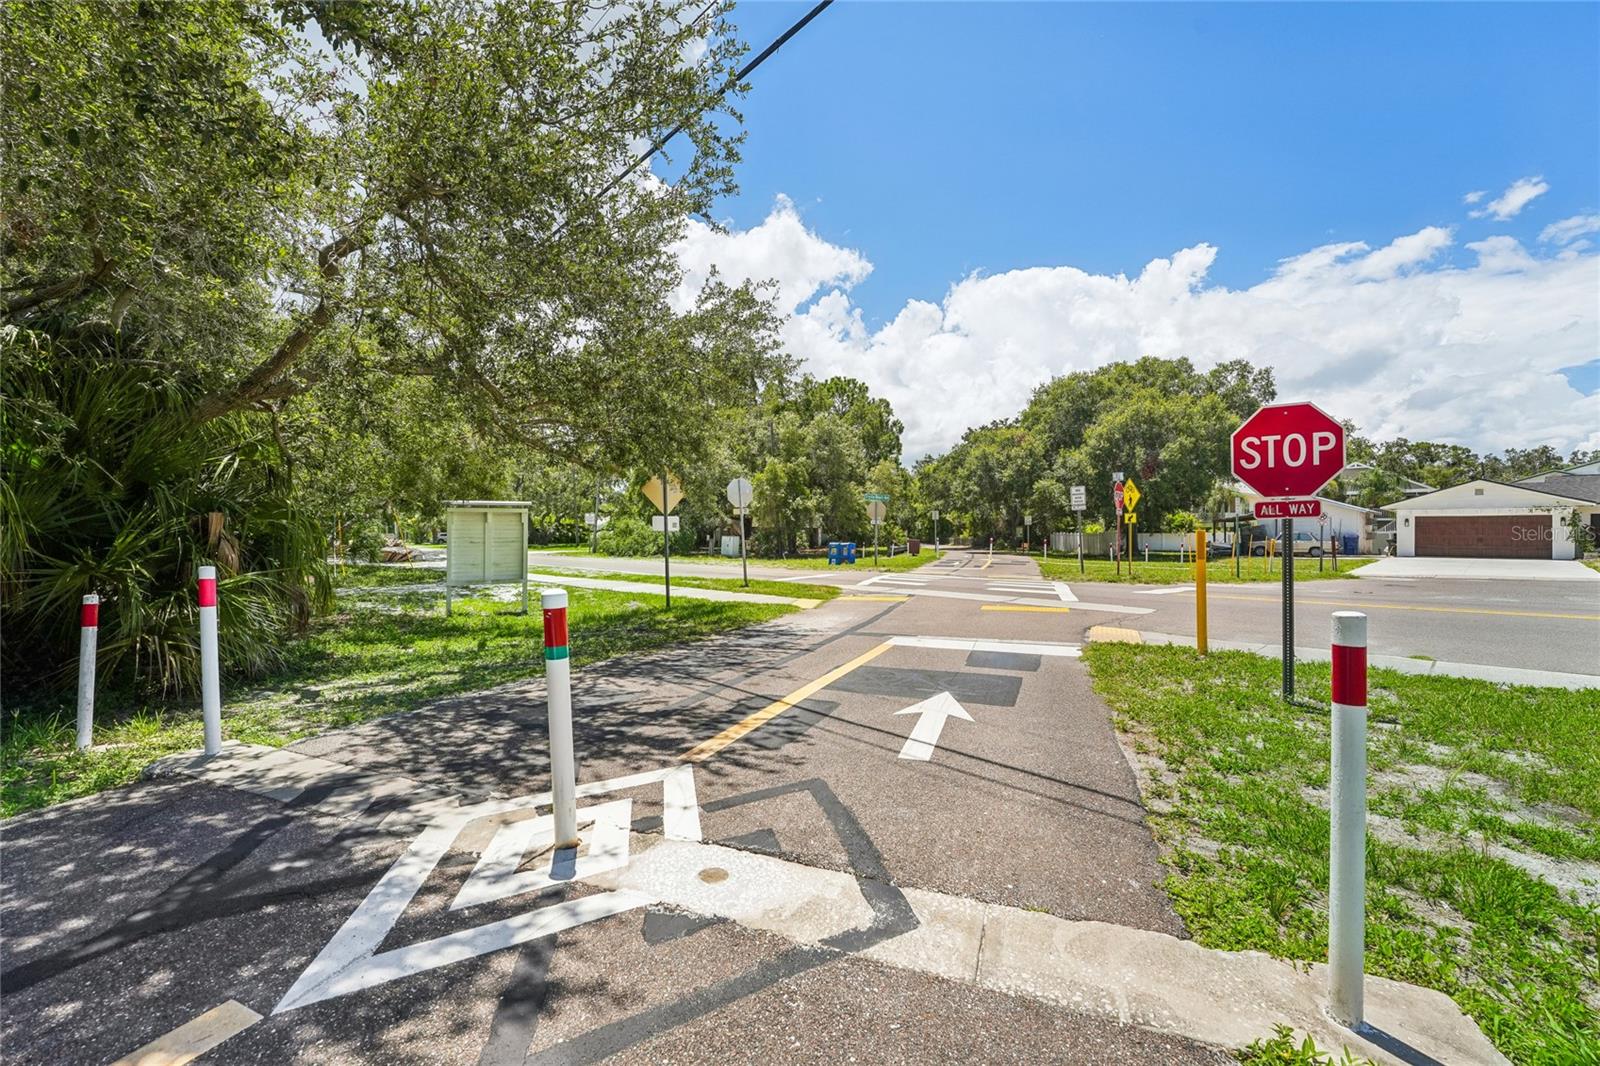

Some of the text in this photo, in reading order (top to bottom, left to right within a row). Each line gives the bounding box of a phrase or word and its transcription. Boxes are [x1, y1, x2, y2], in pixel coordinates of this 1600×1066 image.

[1239, 431, 1336, 470] STOP
[1260, 503, 1315, 516] ALL WAY
